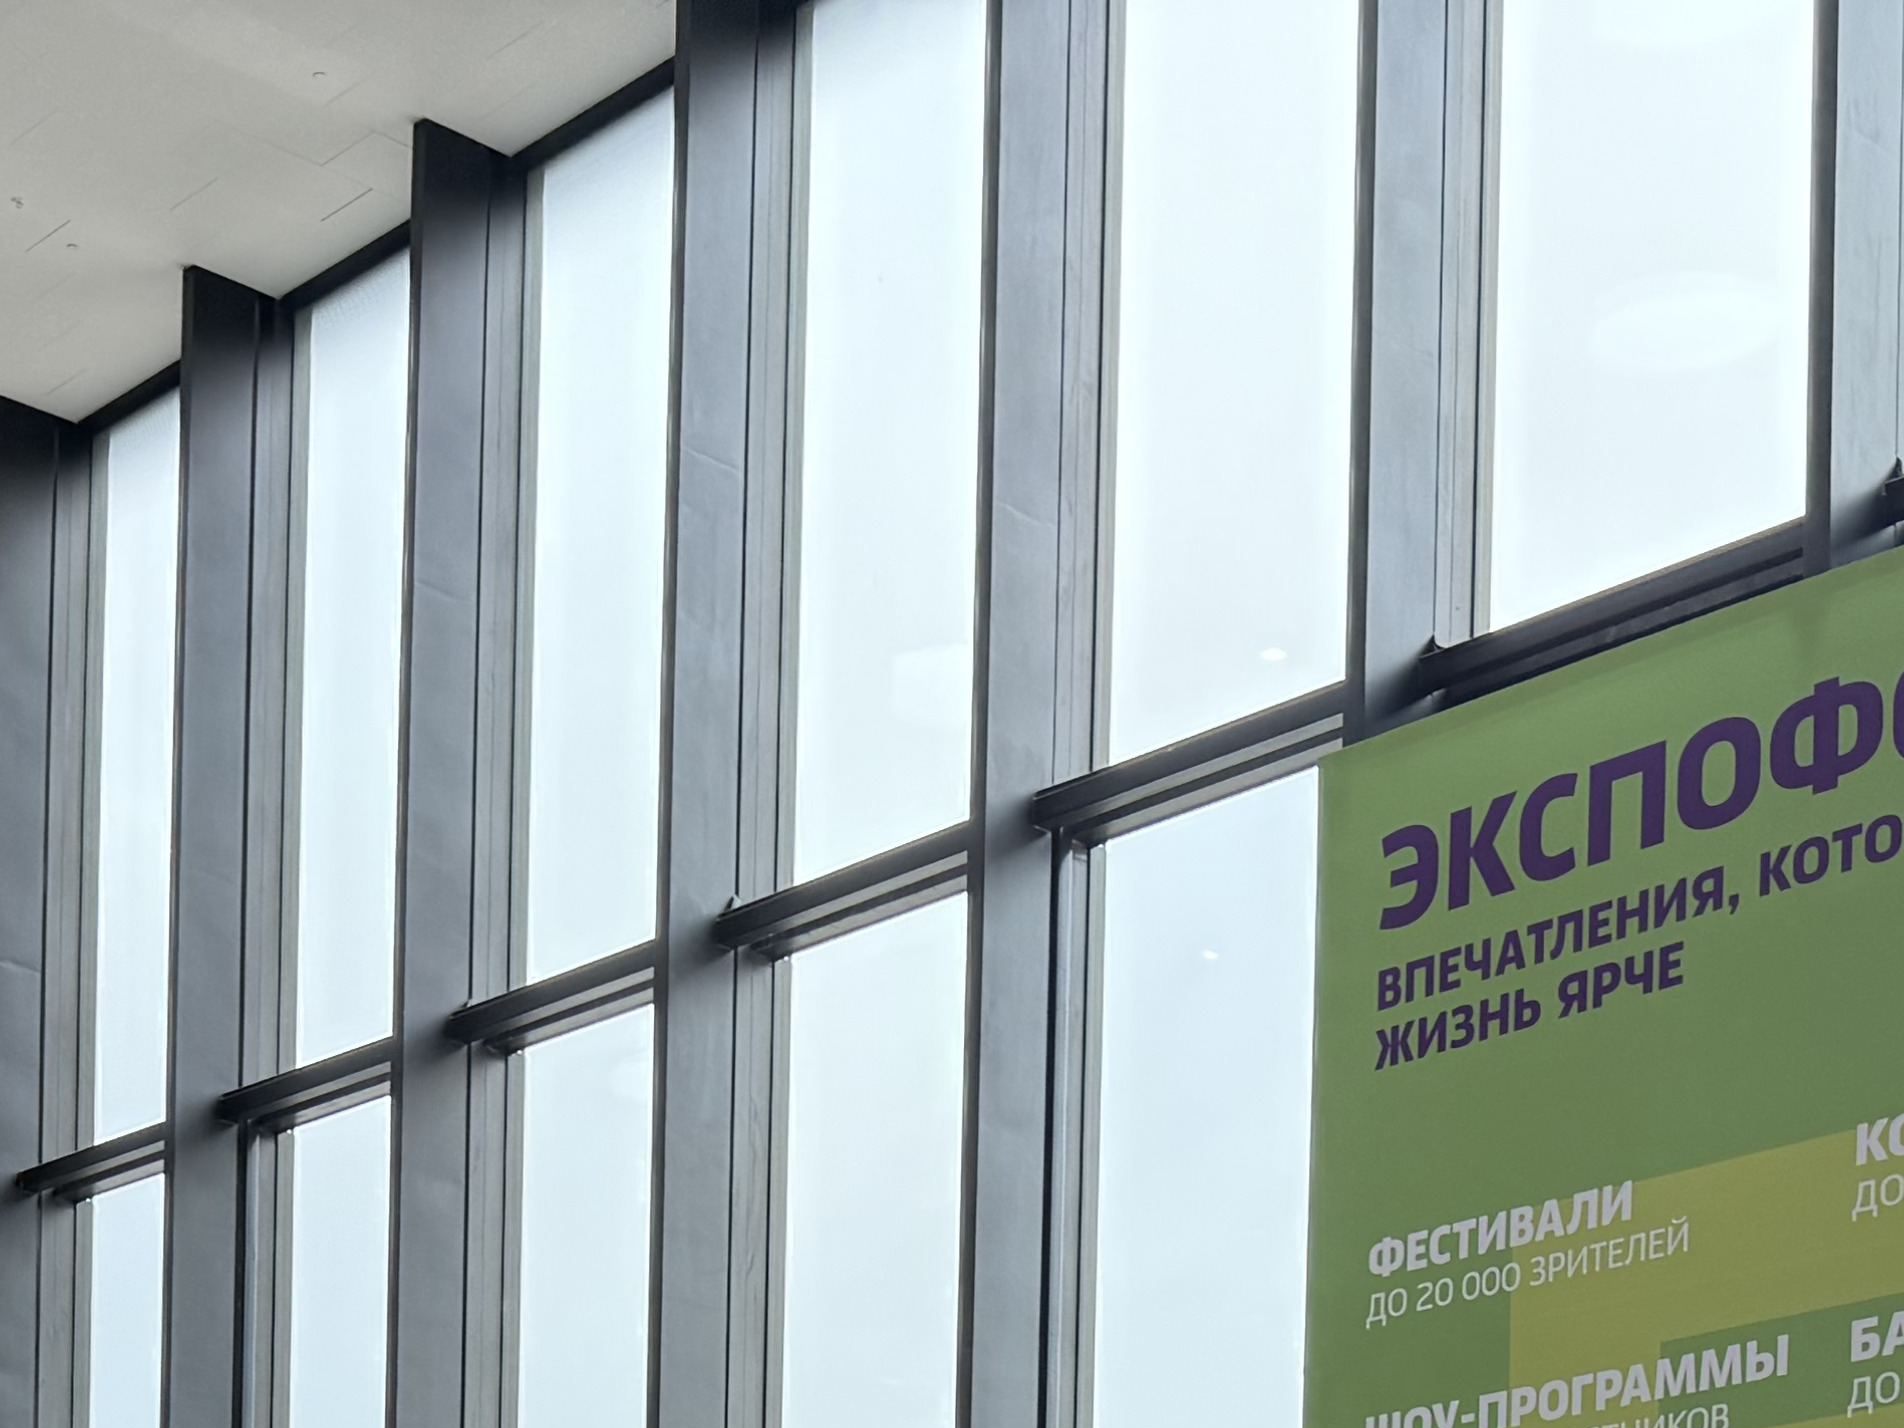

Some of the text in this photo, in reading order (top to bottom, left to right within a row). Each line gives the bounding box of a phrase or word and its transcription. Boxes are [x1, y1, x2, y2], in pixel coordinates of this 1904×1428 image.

[1376, 866, 1742, 1012] ВПЕЧАТЛЕНИЯ,
[1374, 940, 1686, 1072] ЖИЗНЬ ЯРЧЕ
[1364, 1215, 1692, 1331] ДО 20 000 ЗРИТЕЛЕЙ
[1367, 1179, 1636, 1280] ФЕСТИВАЛИ
[1846, 1369, 1901, 1420] ДО
